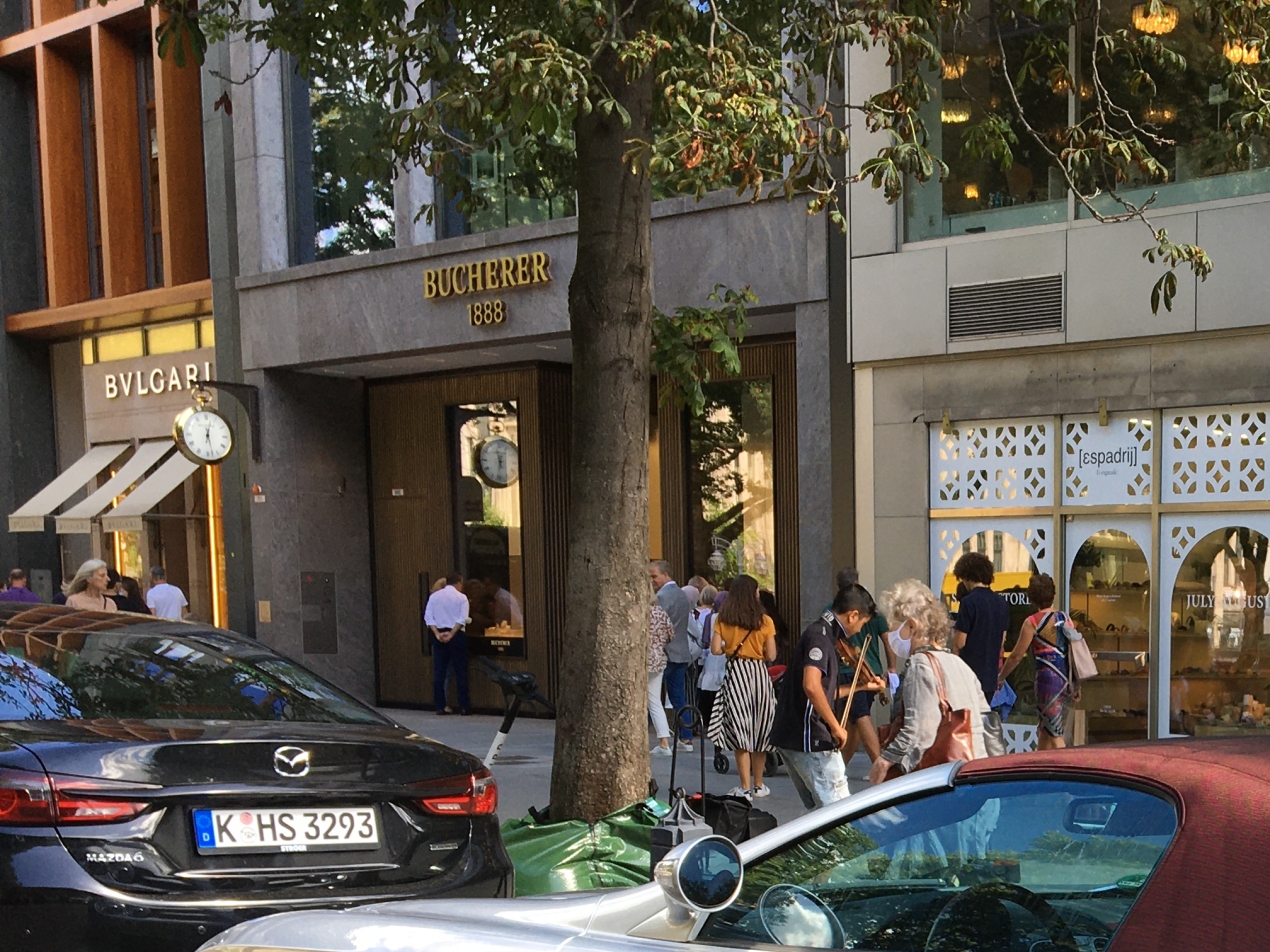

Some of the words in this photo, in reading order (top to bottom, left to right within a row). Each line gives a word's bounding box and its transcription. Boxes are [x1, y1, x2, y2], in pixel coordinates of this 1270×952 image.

[423, 251, 551, 299] BUCHERER
[466, 299, 505, 326] 1888
[105, 362, 212, 399] BVLGARI
[1186, 594, 1214, 610] JULY
[216, 814, 237, 843] K
[256, 813, 296, 842] HS
[303, 812, 373, 840] 3293
